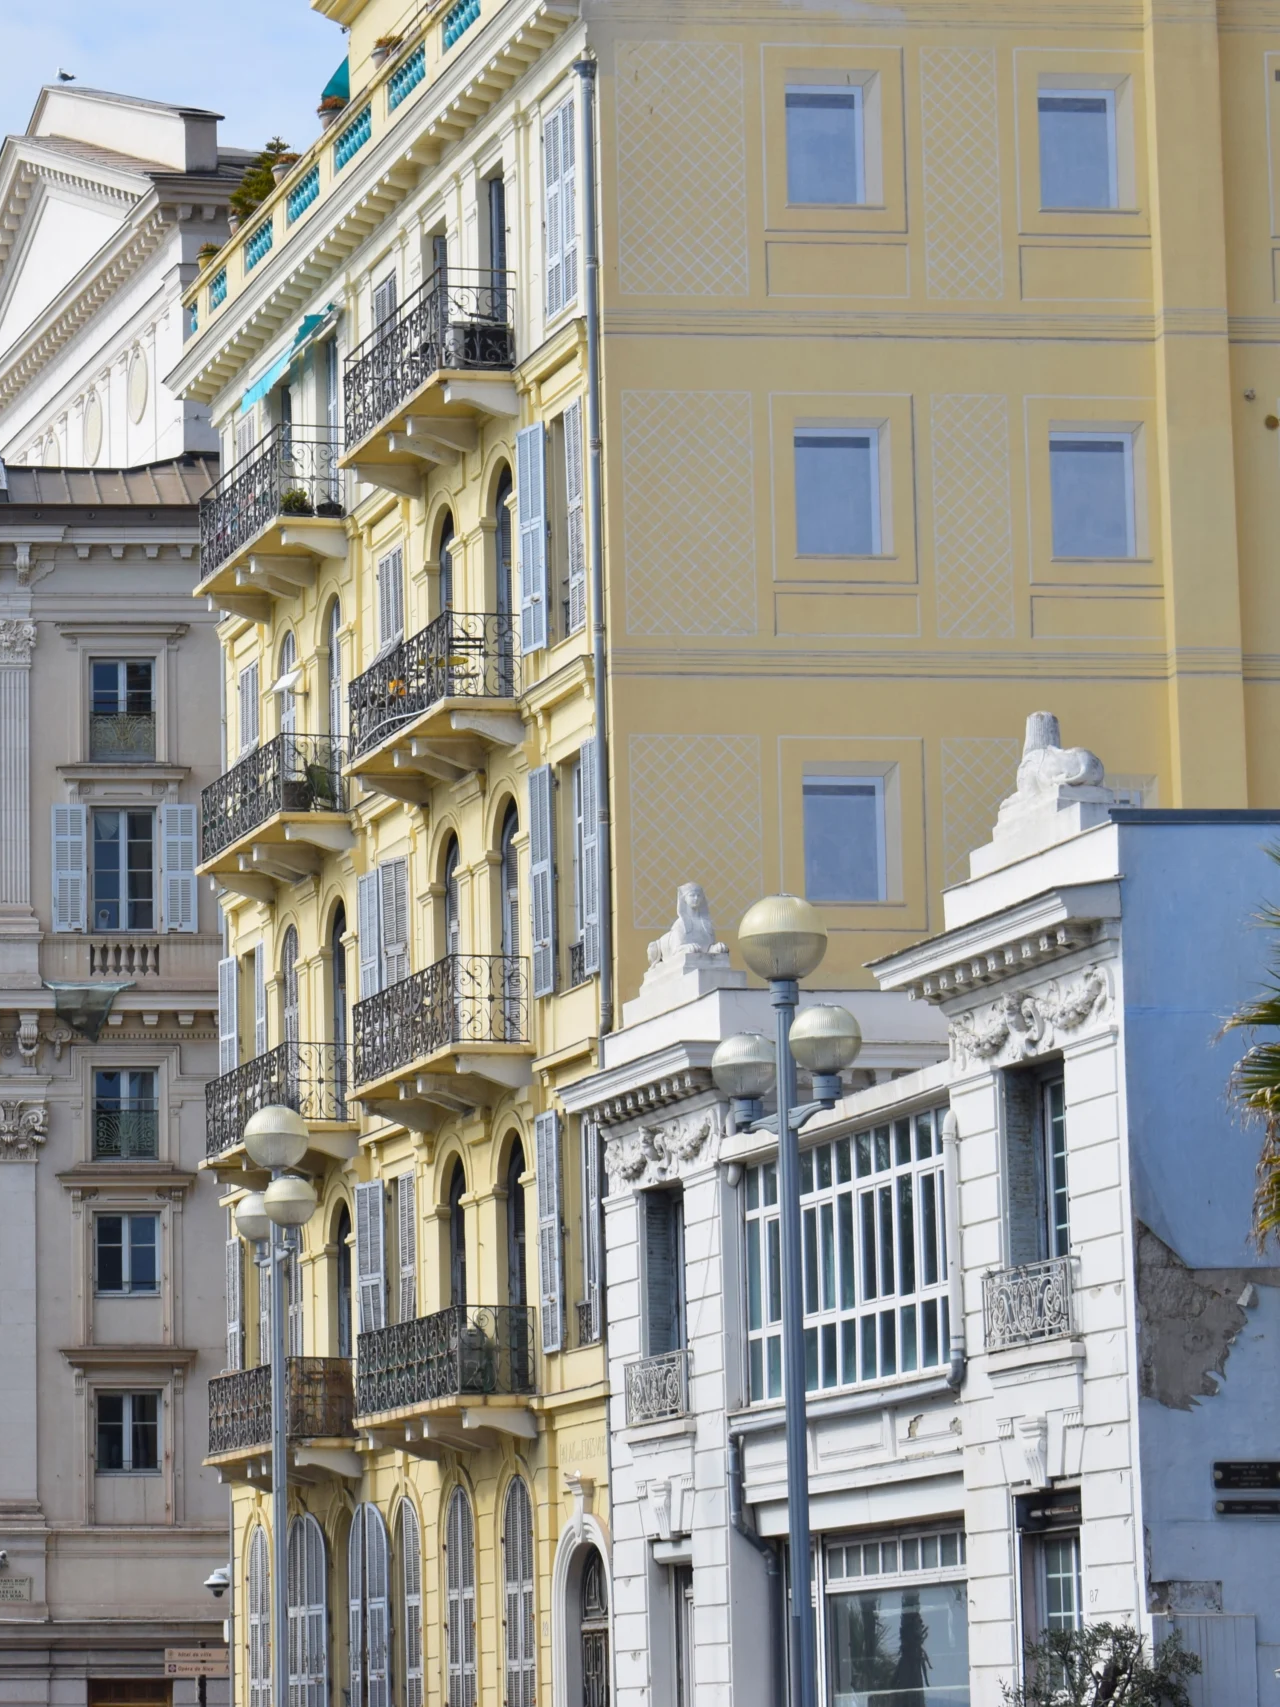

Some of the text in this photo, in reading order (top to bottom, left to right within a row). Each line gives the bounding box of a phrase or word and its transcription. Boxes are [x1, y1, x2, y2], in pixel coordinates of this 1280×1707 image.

[1090, 1588, 1099, 1603] 87
[177, 1664, 193, 1672] Opéra
[201, 1664, 214, 1672] Nice
